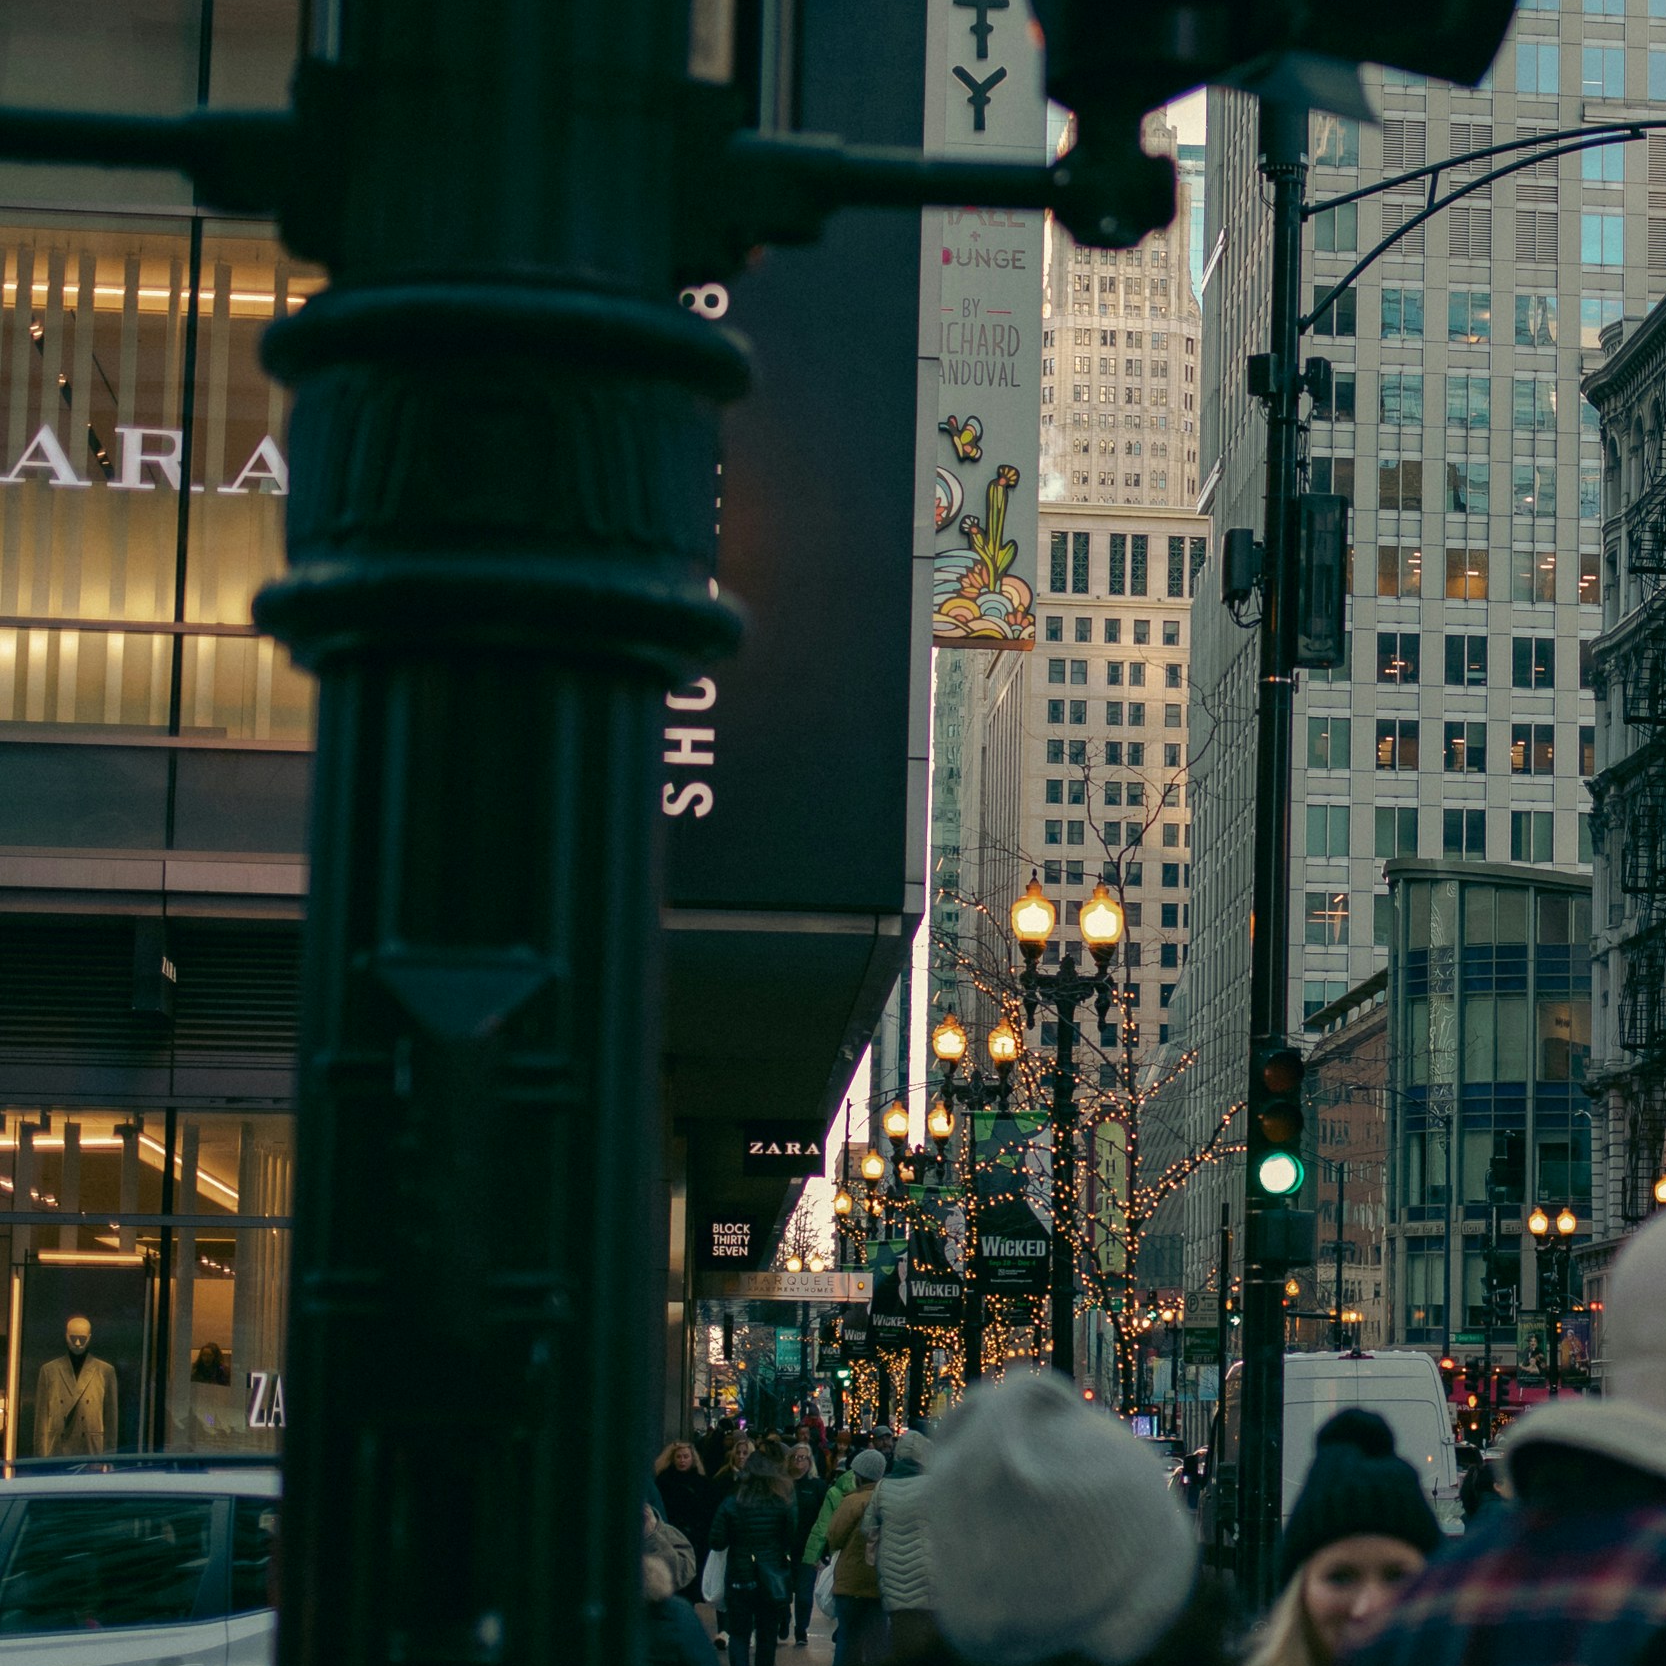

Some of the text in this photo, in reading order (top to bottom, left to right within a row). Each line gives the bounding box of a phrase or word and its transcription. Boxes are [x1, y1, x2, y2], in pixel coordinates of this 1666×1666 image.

[962, 297, 981, 318] BY
[748, 1141, 821, 1155] ZARA
[712, 1223, 751, 1234] BLOCK
[712, 1234, 751, 1245] THIRTY
[712, 1245, 749, 1257] SEVEN
[981, 1236, 1046, 1257] WICKED
[747, 1276, 835, 1286] MARQUEE
[911, 1281, 960, 1297] WICKED
